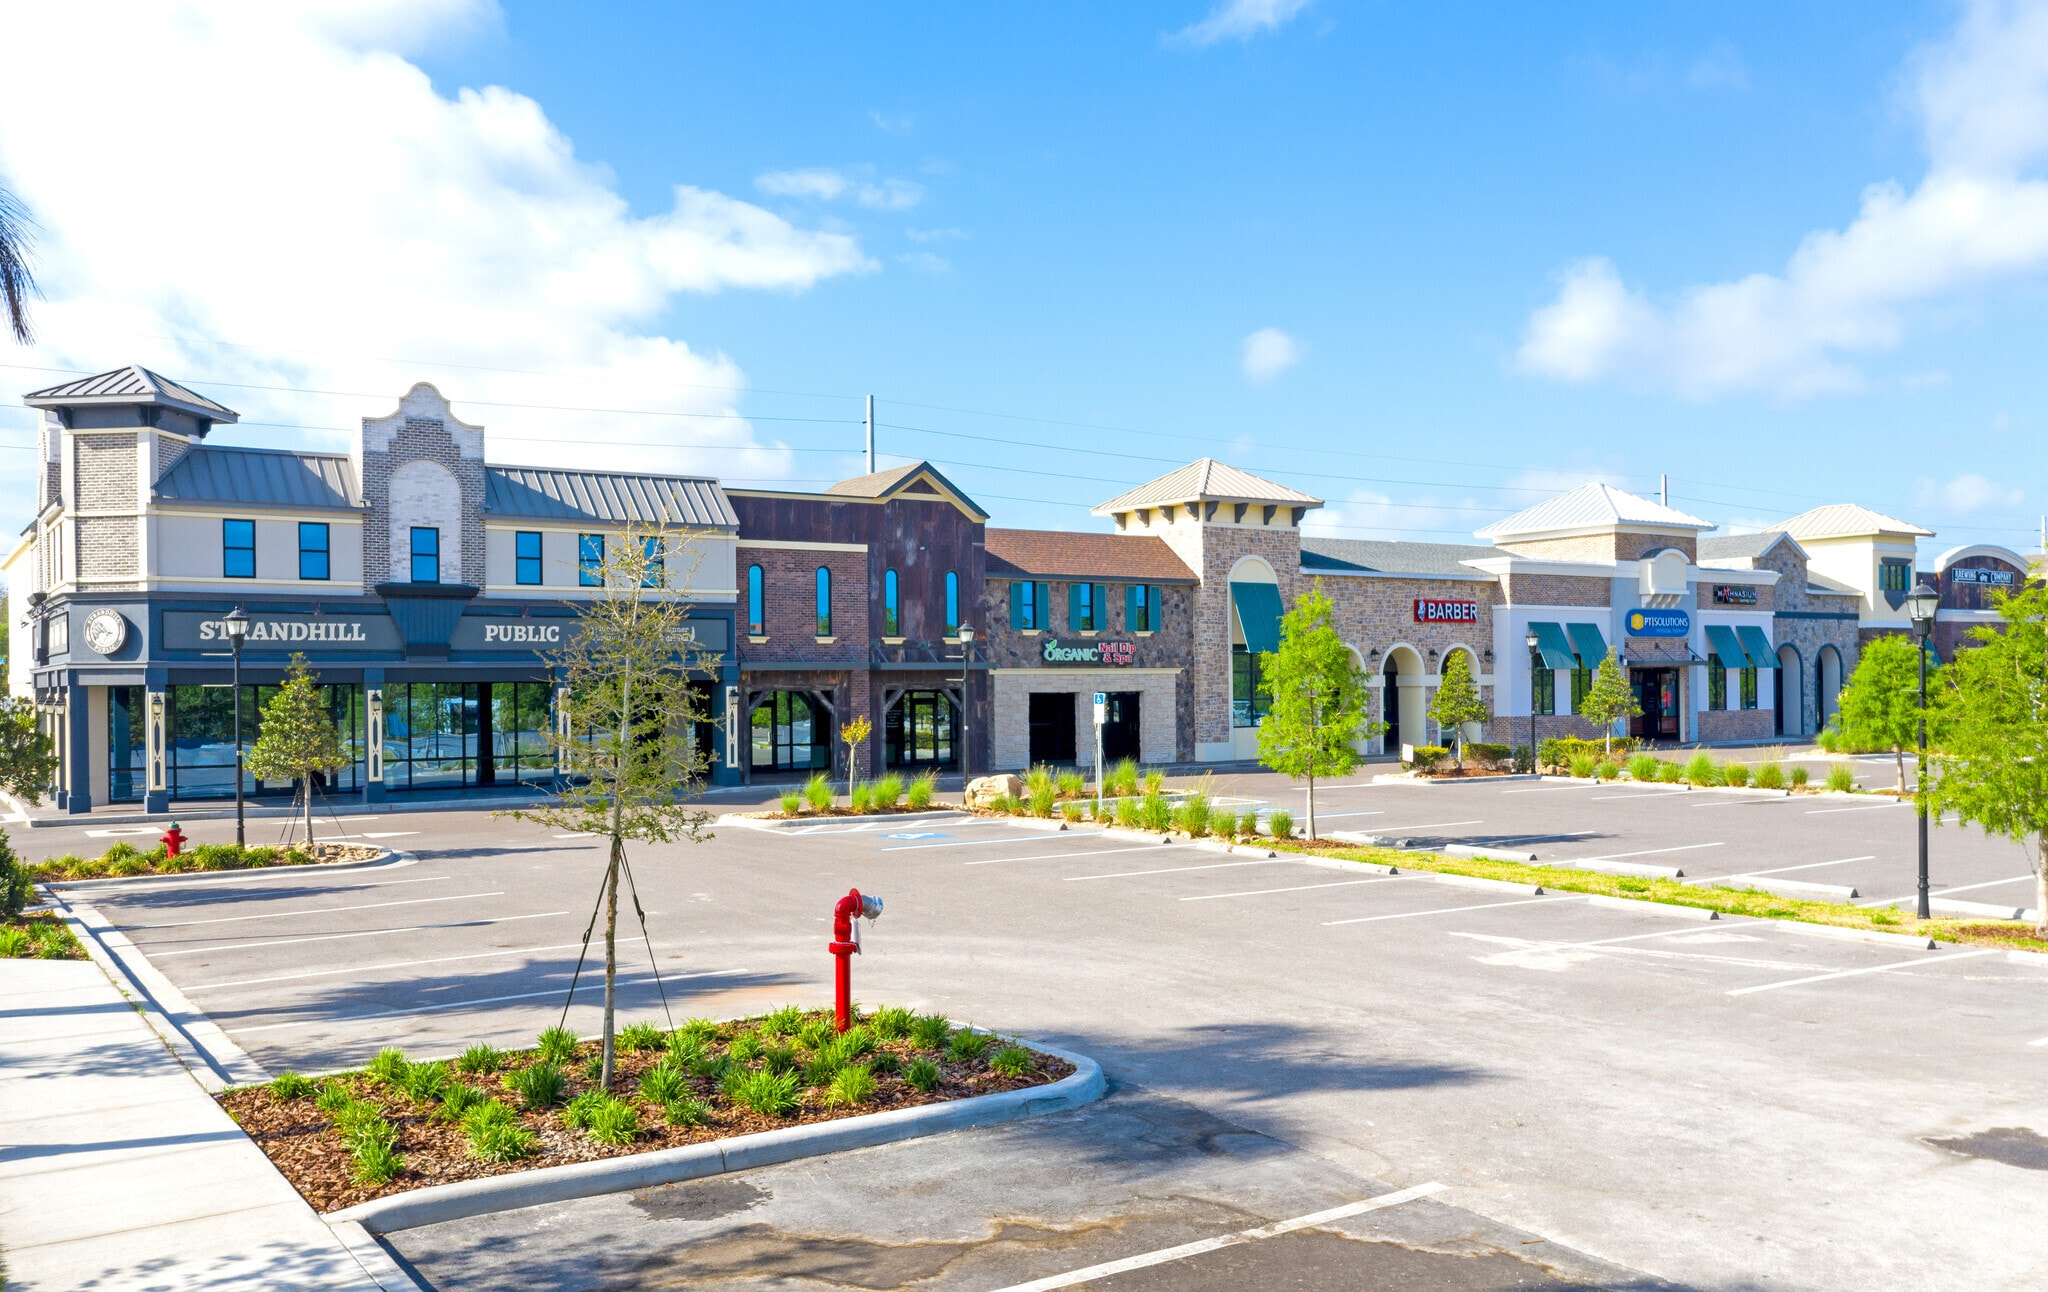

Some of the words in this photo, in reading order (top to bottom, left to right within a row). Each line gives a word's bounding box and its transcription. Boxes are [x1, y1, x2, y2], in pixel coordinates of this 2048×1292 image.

[1955, 569, 1977, 581] BREWING
[1991, 572, 2012, 584] COMPANY
[1427, 602, 1478, 620] BARBER
[484, 624, 560, 642] PUBLIC
[1043, 647, 1098, 662] ORGANIC
[1097, 642, 1118, 653] Nail
[1119, 642, 1137, 655] Dip
[1102, 653, 1112, 663] &
[1113, 653, 1133, 665] Spa
